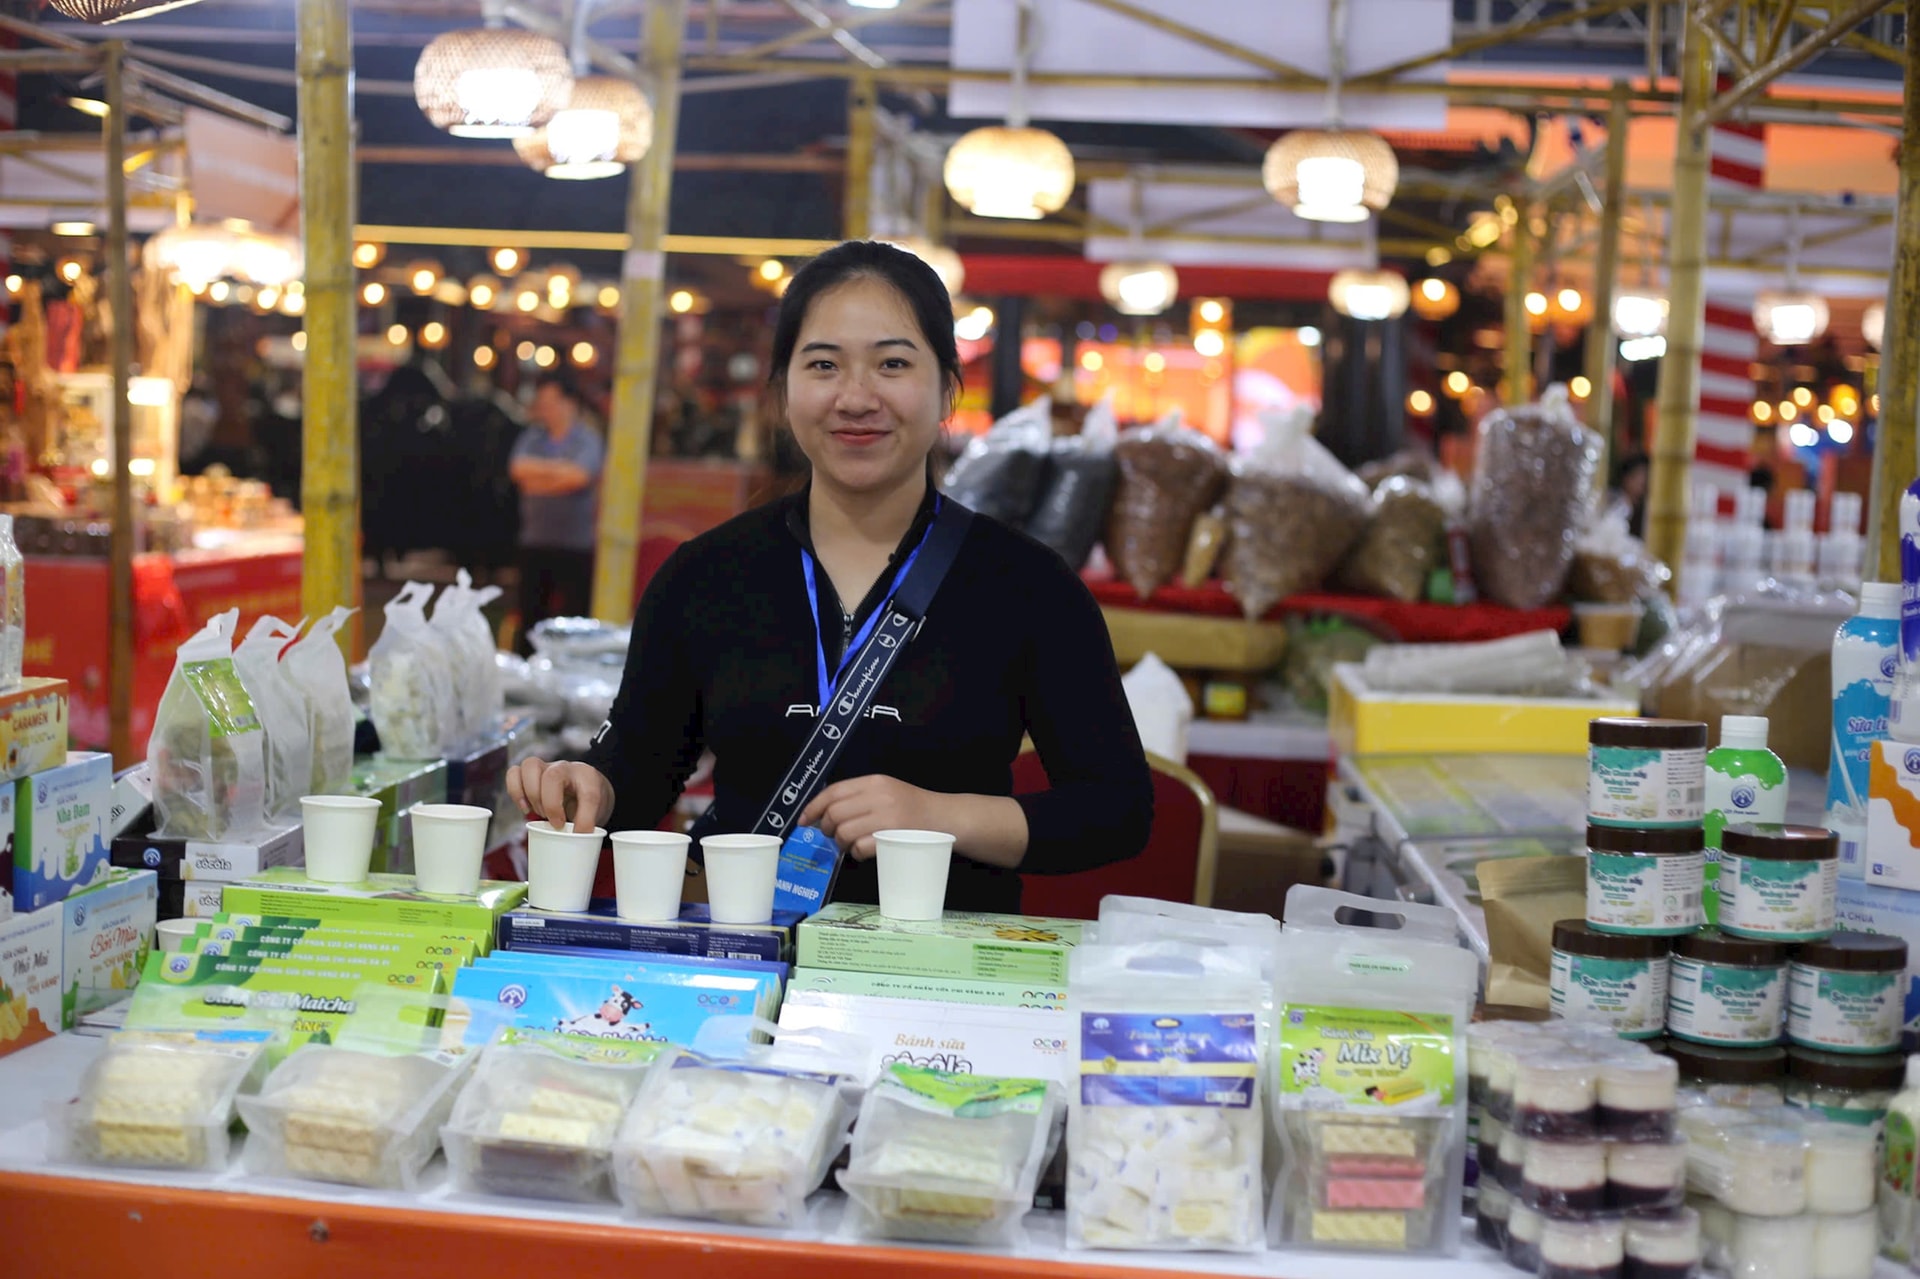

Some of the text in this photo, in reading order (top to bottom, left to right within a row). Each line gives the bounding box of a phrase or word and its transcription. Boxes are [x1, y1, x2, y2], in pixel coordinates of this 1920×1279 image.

[837, 656, 881, 716] Champion
[12, 711, 49, 731] CARAMEN
[782, 748, 825, 806] Champion
[792, 883, 820, 901] NGHIỆP
[1847, 911, 1874, 924] CHUA
[291, 993, 355, 1014] Matcha
[894, 1033, 966, 1051] Bánh sữa
[1336, 1041, 1383, 1064] Mix
